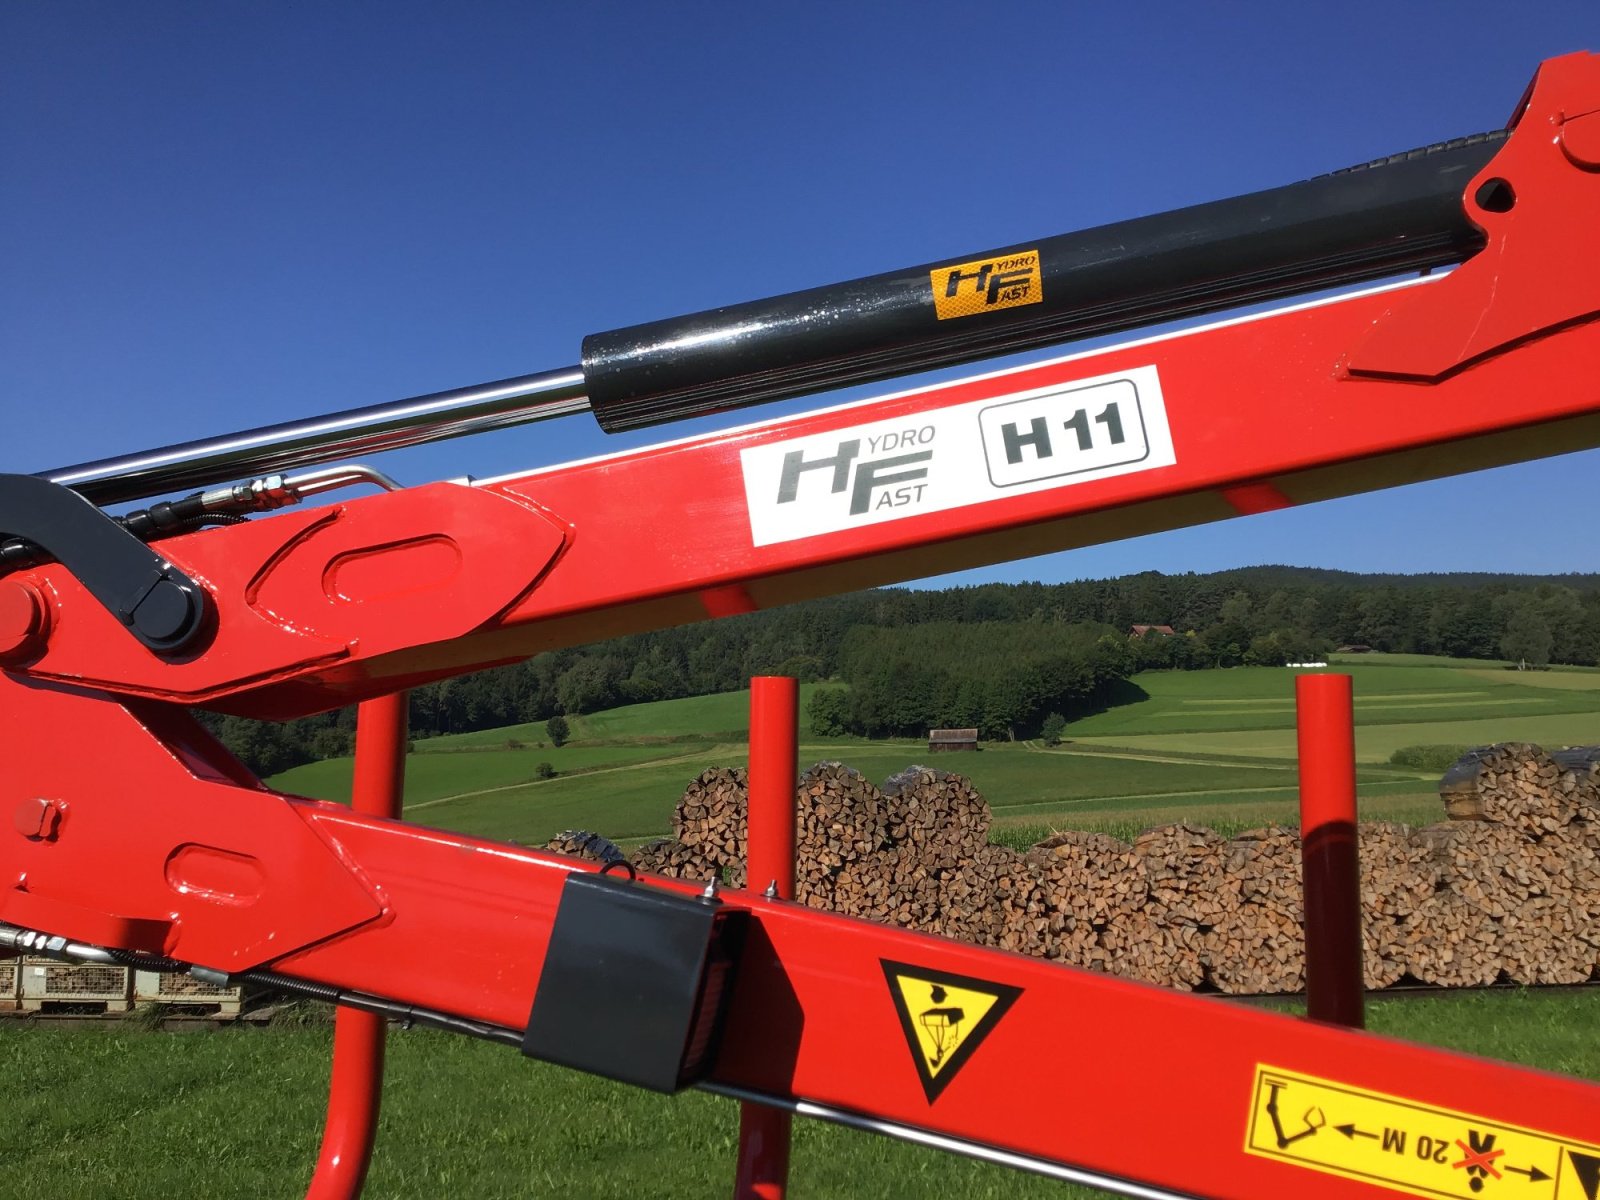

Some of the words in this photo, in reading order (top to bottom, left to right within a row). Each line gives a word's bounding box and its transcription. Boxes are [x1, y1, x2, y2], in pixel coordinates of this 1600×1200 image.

[1001, 416, 1054, 465] H
[1063, 402, 1126, 451] 11
[1382, 1128, 1407, 1155] M
[1416, 1135, 1450, 1164] 20
